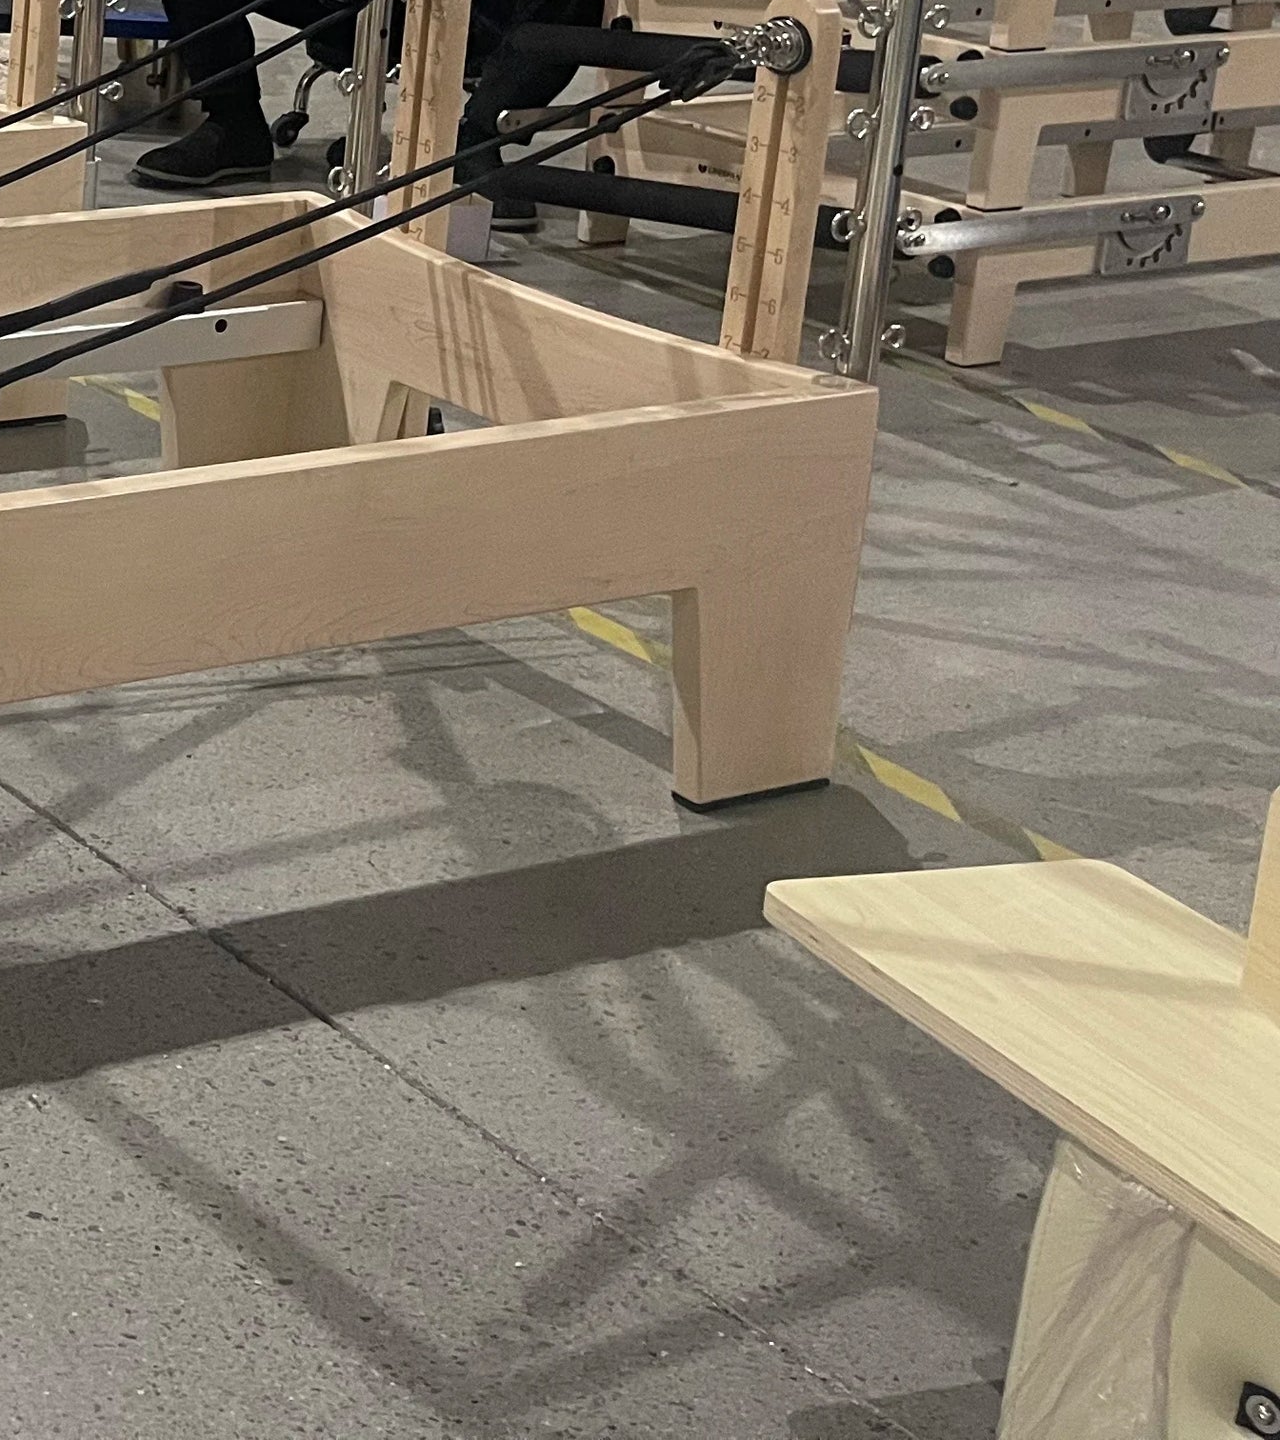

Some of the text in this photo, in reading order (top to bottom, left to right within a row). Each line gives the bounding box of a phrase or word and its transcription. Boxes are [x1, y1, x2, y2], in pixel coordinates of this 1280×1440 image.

[757, 85, 767, 102] 2
[750, 136, 759, 152] 3
[742, 187, 752, 204] 4
[780, 198, 790, 215] 4
